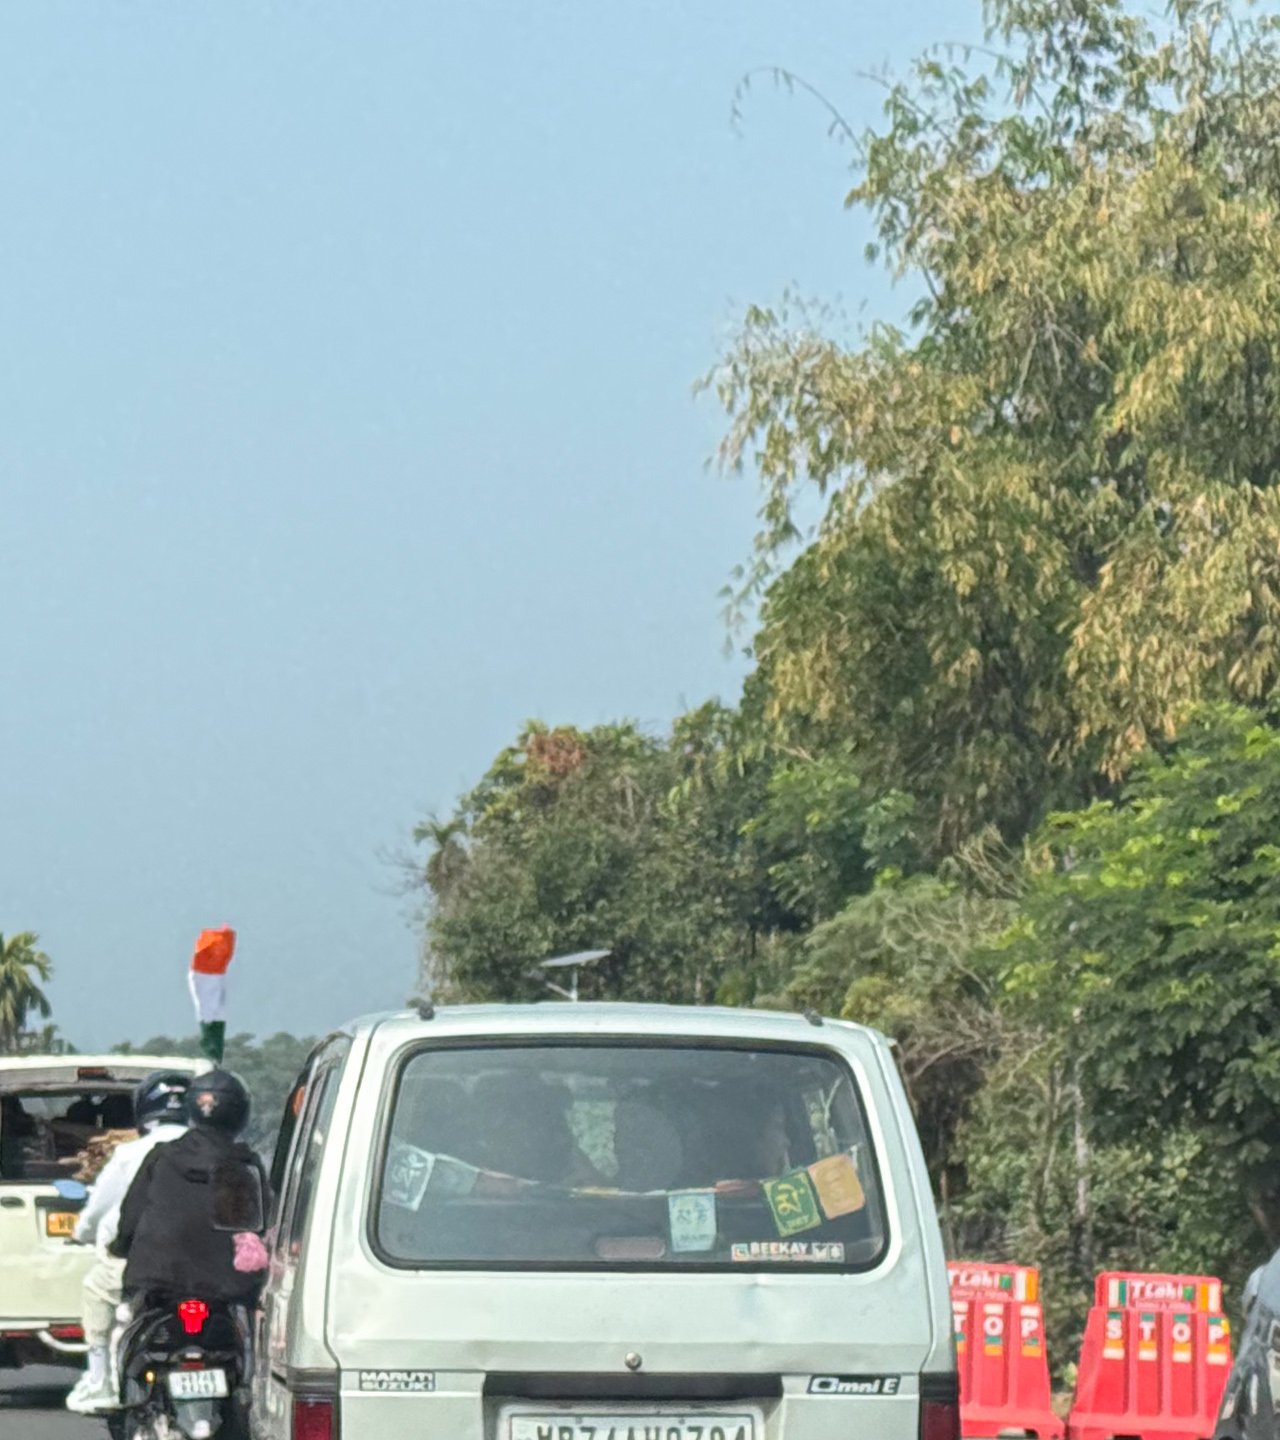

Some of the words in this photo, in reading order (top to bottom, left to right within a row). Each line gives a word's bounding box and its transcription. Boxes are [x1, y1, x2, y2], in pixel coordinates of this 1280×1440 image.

[750, 1242, 808, 1255] BEEKAY
[953, 1315, 1039, 1337] TOP
[1106, 1319, 1225, 1345] STOP
[361, 1371, 433, 1381] MARUTI
[361, 1381, 433, 1390] SUZUKI
[810, 1377, 880, 1393] Omni
[882, 1378, 898, 1393] E
